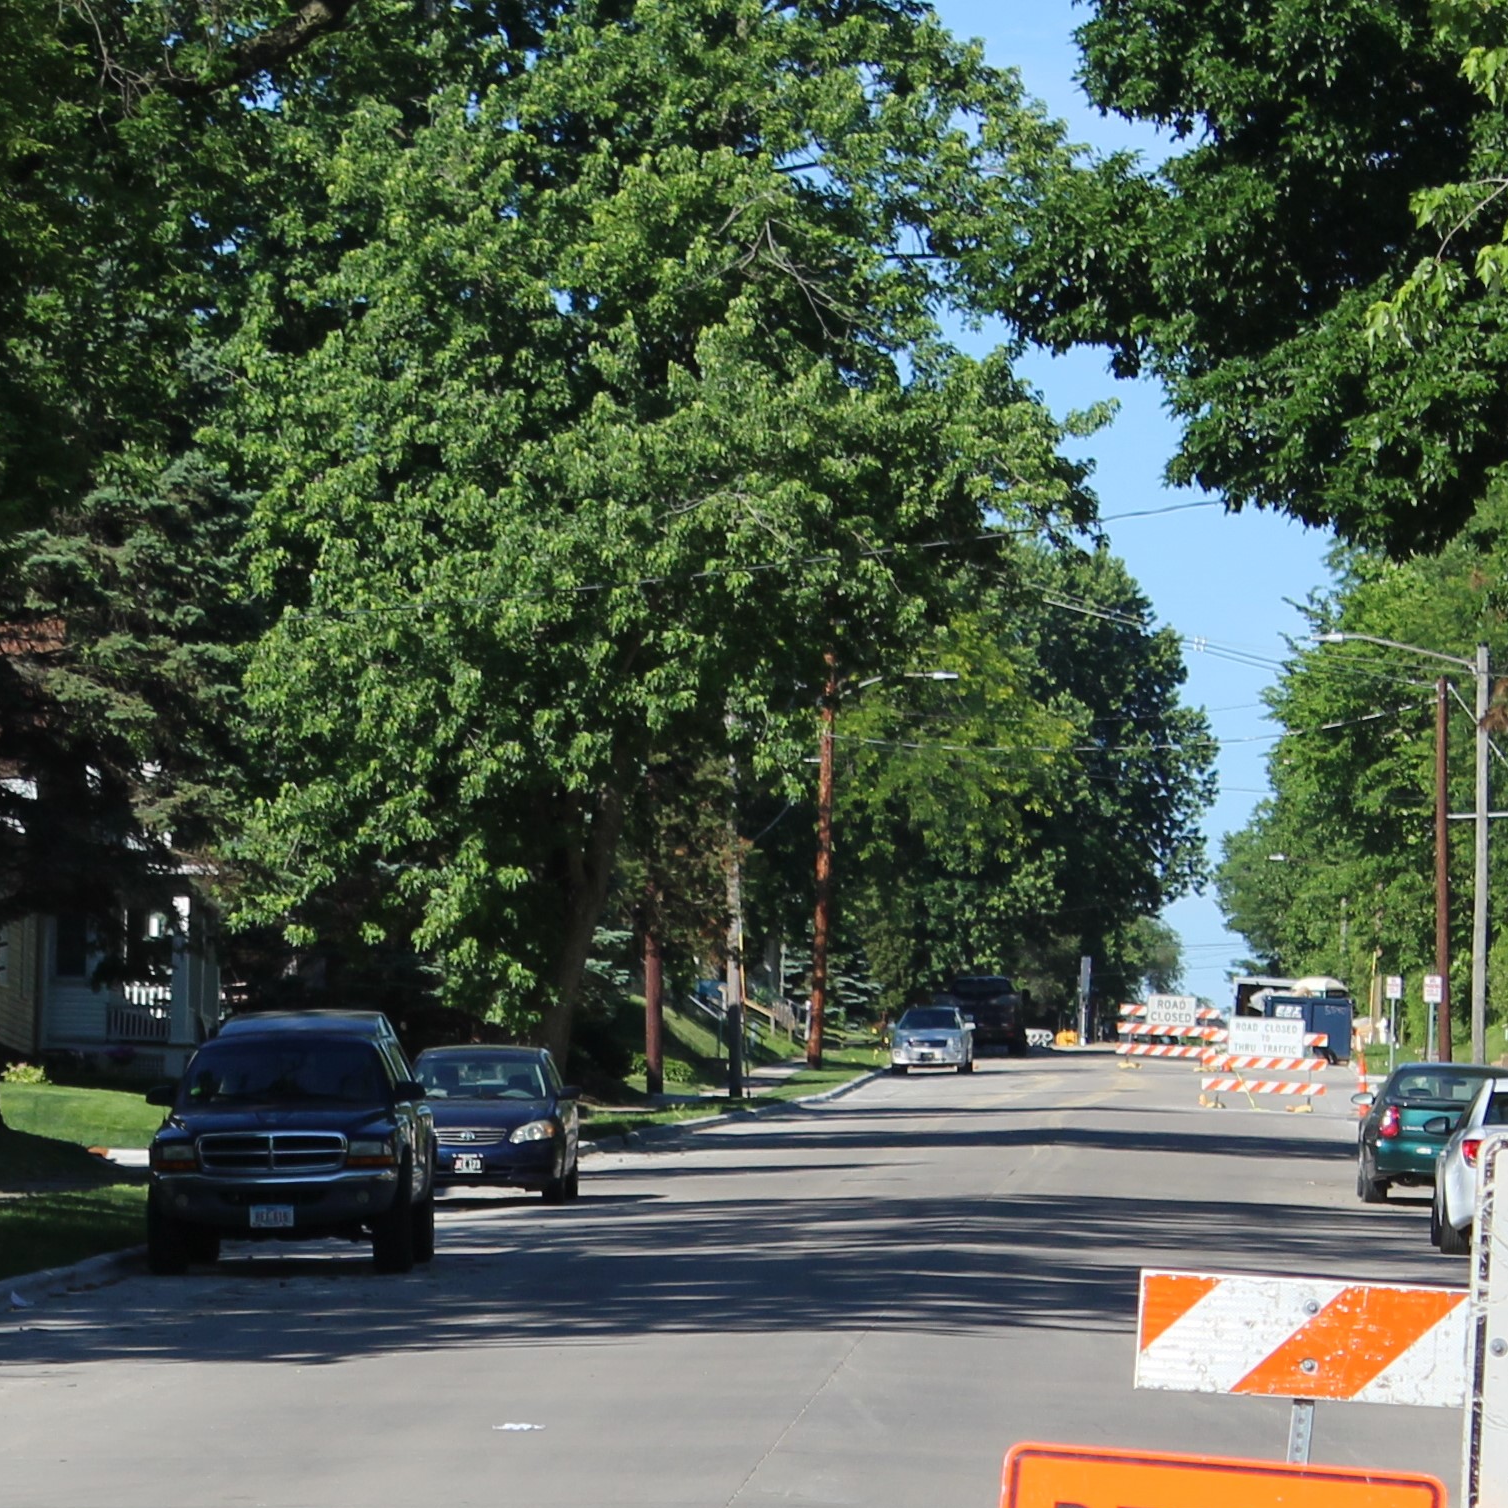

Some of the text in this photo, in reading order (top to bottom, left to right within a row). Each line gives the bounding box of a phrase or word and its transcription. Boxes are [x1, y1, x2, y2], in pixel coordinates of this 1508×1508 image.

[1157, 999, 1187, 1010] ROAD
[1151, 1011, 1192, 1023] CLOSED
[1235, 1022, 1298, 1034] ROAD CLOSED
[1261, 1034, 1271, 1042] TO
[1234, 1043, 1297, 1055] THRU TRAFFIC
